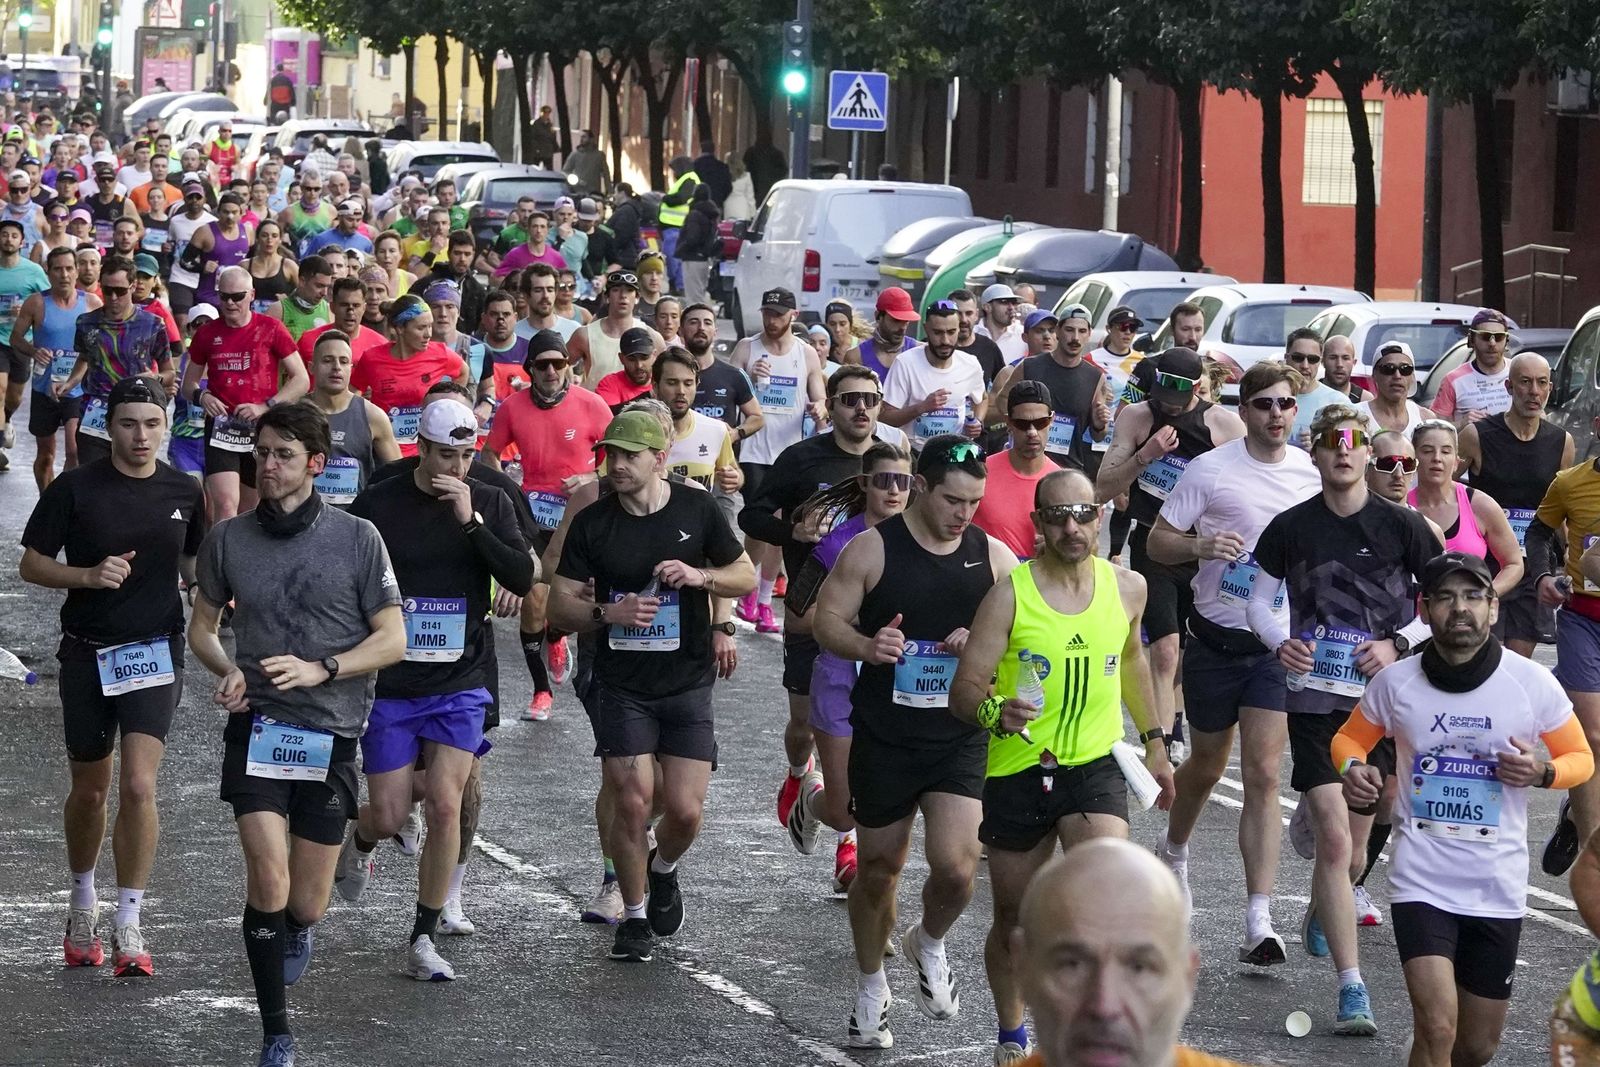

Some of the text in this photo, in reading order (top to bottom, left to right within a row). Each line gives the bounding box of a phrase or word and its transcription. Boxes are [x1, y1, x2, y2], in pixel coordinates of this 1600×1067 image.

[762, 395, 787, 405] RHINO
[215, 431, 251, 444] RICHARD
[326, 458, 354, 467] ZURICH
[1139, 470, 1168, 488] JESUS
[332, 486, 357, 494] DANIELA
[540, 494, 567, 505] ZURICH
[1221, 580, 1250, 598] DAVID
[421, 602, 460, 611] ZURICH
[420, 621, 441, 630] 8141
[623, 624, 666, 636] IRIZAR
[414, 633, 447, 647] MMB
[1327, 629, 1365, 644] ZURICH
[1065, 643, 1089, 651] adidas
[122, 651, 145, 661] 7649
[1325, 648, 1345, 661] 8803
[114, 661, 159, 680] BOSCO
[922, 665, 945, 674] 9440
[915, 678, 948, 692] NICK
[280, 733, 305, 746] 7232
[272, 747, 308, 764] GUIG
[1442, 761, 1494, 776] ZURICH
[1442, 785, 1470, 798] 9105
[1425, 800, 1484, 821] TOMÁS
